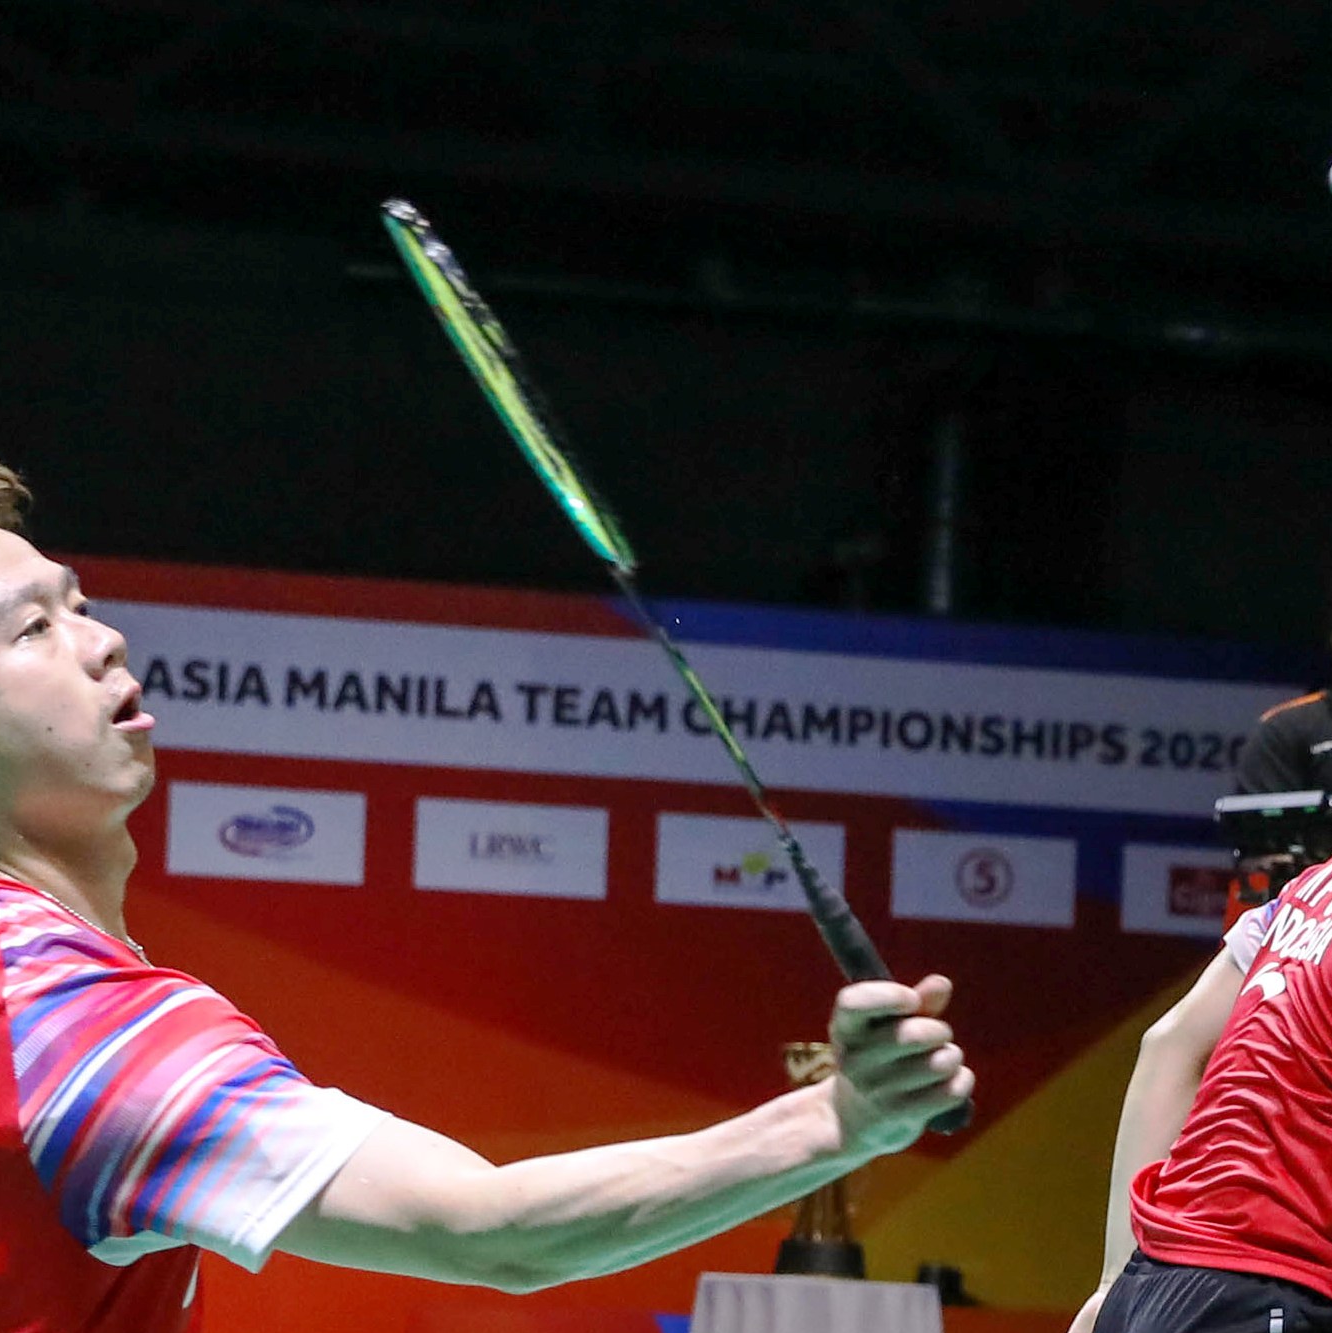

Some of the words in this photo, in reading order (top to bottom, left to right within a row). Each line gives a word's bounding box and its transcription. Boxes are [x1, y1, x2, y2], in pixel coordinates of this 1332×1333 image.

[142, 658, 268, 706] ASIA
[286, 667, 501, 722] MANILA
[517, 683, 668, 733] TEAM
[681, 696, 1128, 767] CHAMPIONSHIPS
